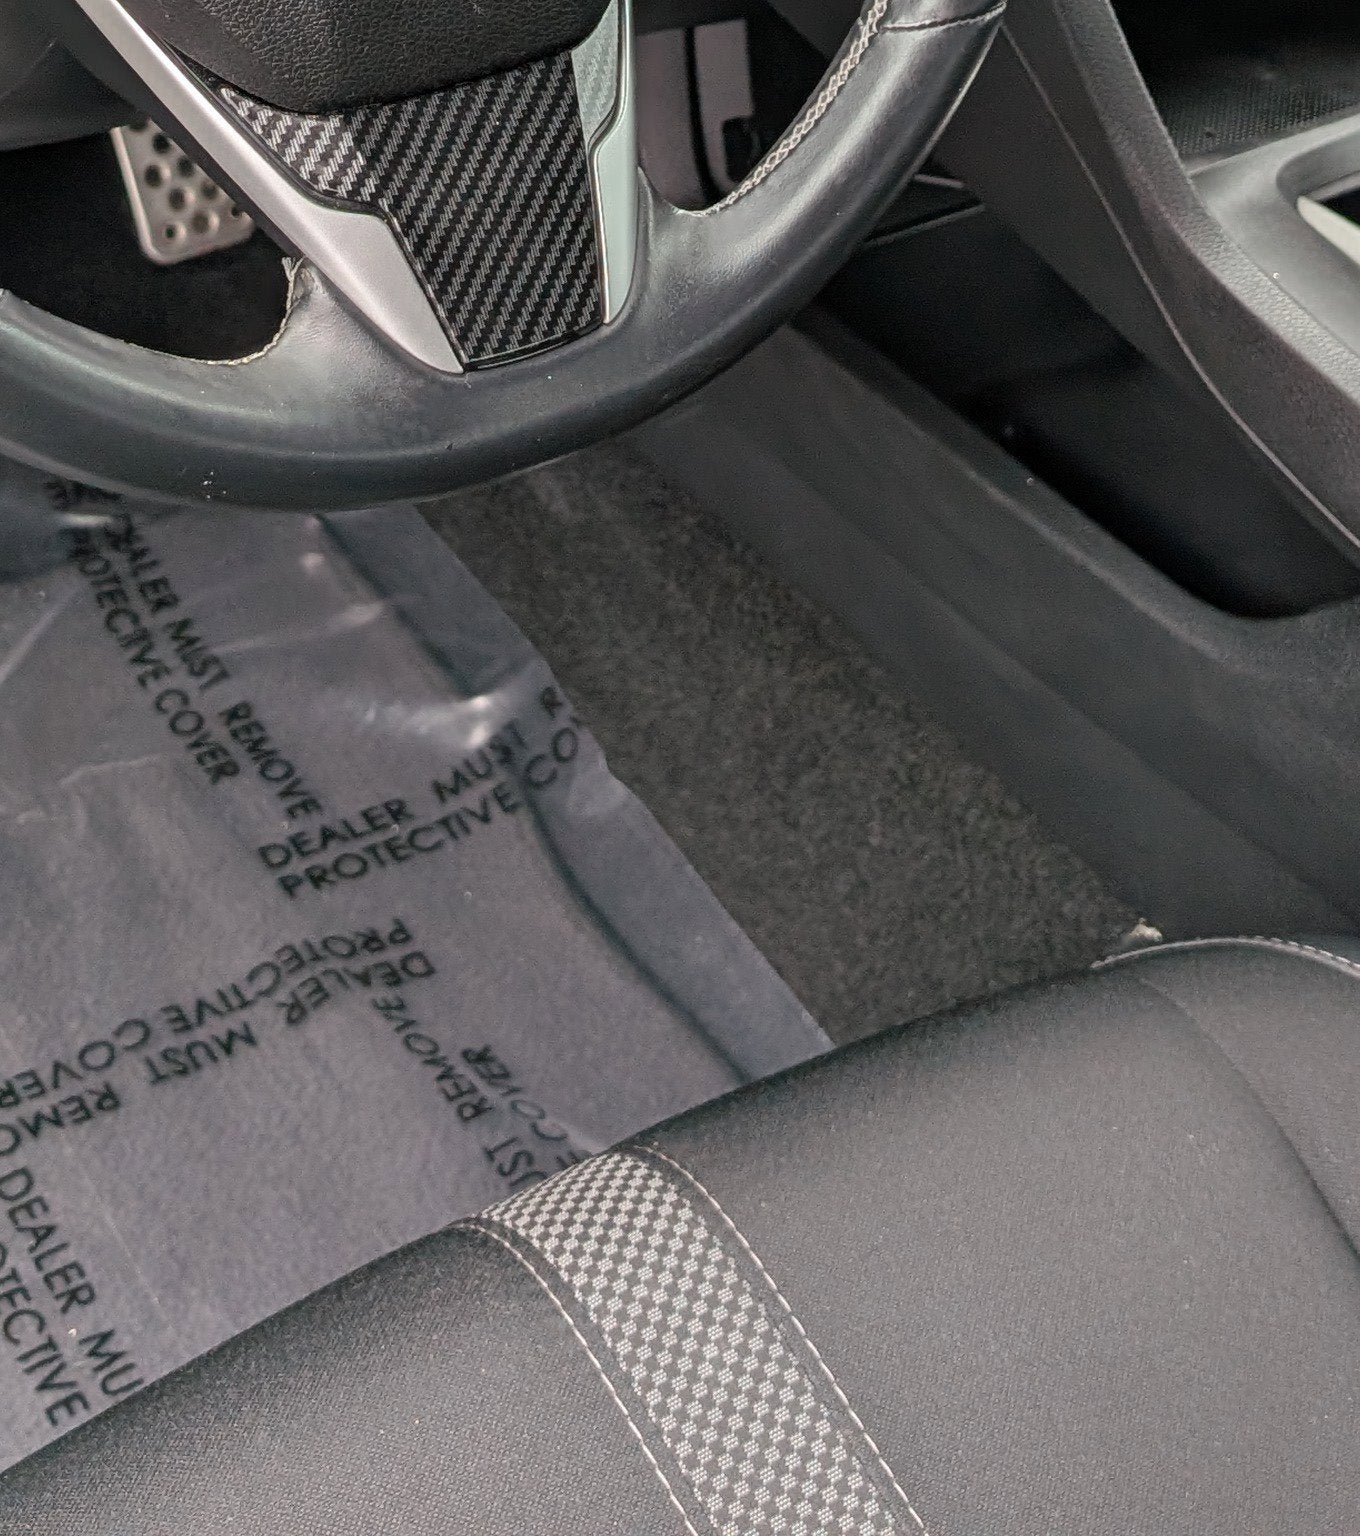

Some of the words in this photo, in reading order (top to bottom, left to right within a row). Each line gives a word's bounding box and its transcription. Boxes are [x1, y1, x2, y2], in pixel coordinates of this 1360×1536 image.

[154, 687, 241, 787] COVER
[162, 617, 233, 693] MUST
[218, 700, 324, 821] REMOVE
[258, 798, 414, 871] DEALER
[430, 720, 528, 804] MUST
[277, 781, 524, 899] PROTECTIVE
[160, 916, 414, 1035] PROTECTIVE
[276, 950, 437, 1028] DEALER
[143, 1019, 259, 1087] MUST
[77, 1328, 145, 1397] MU
